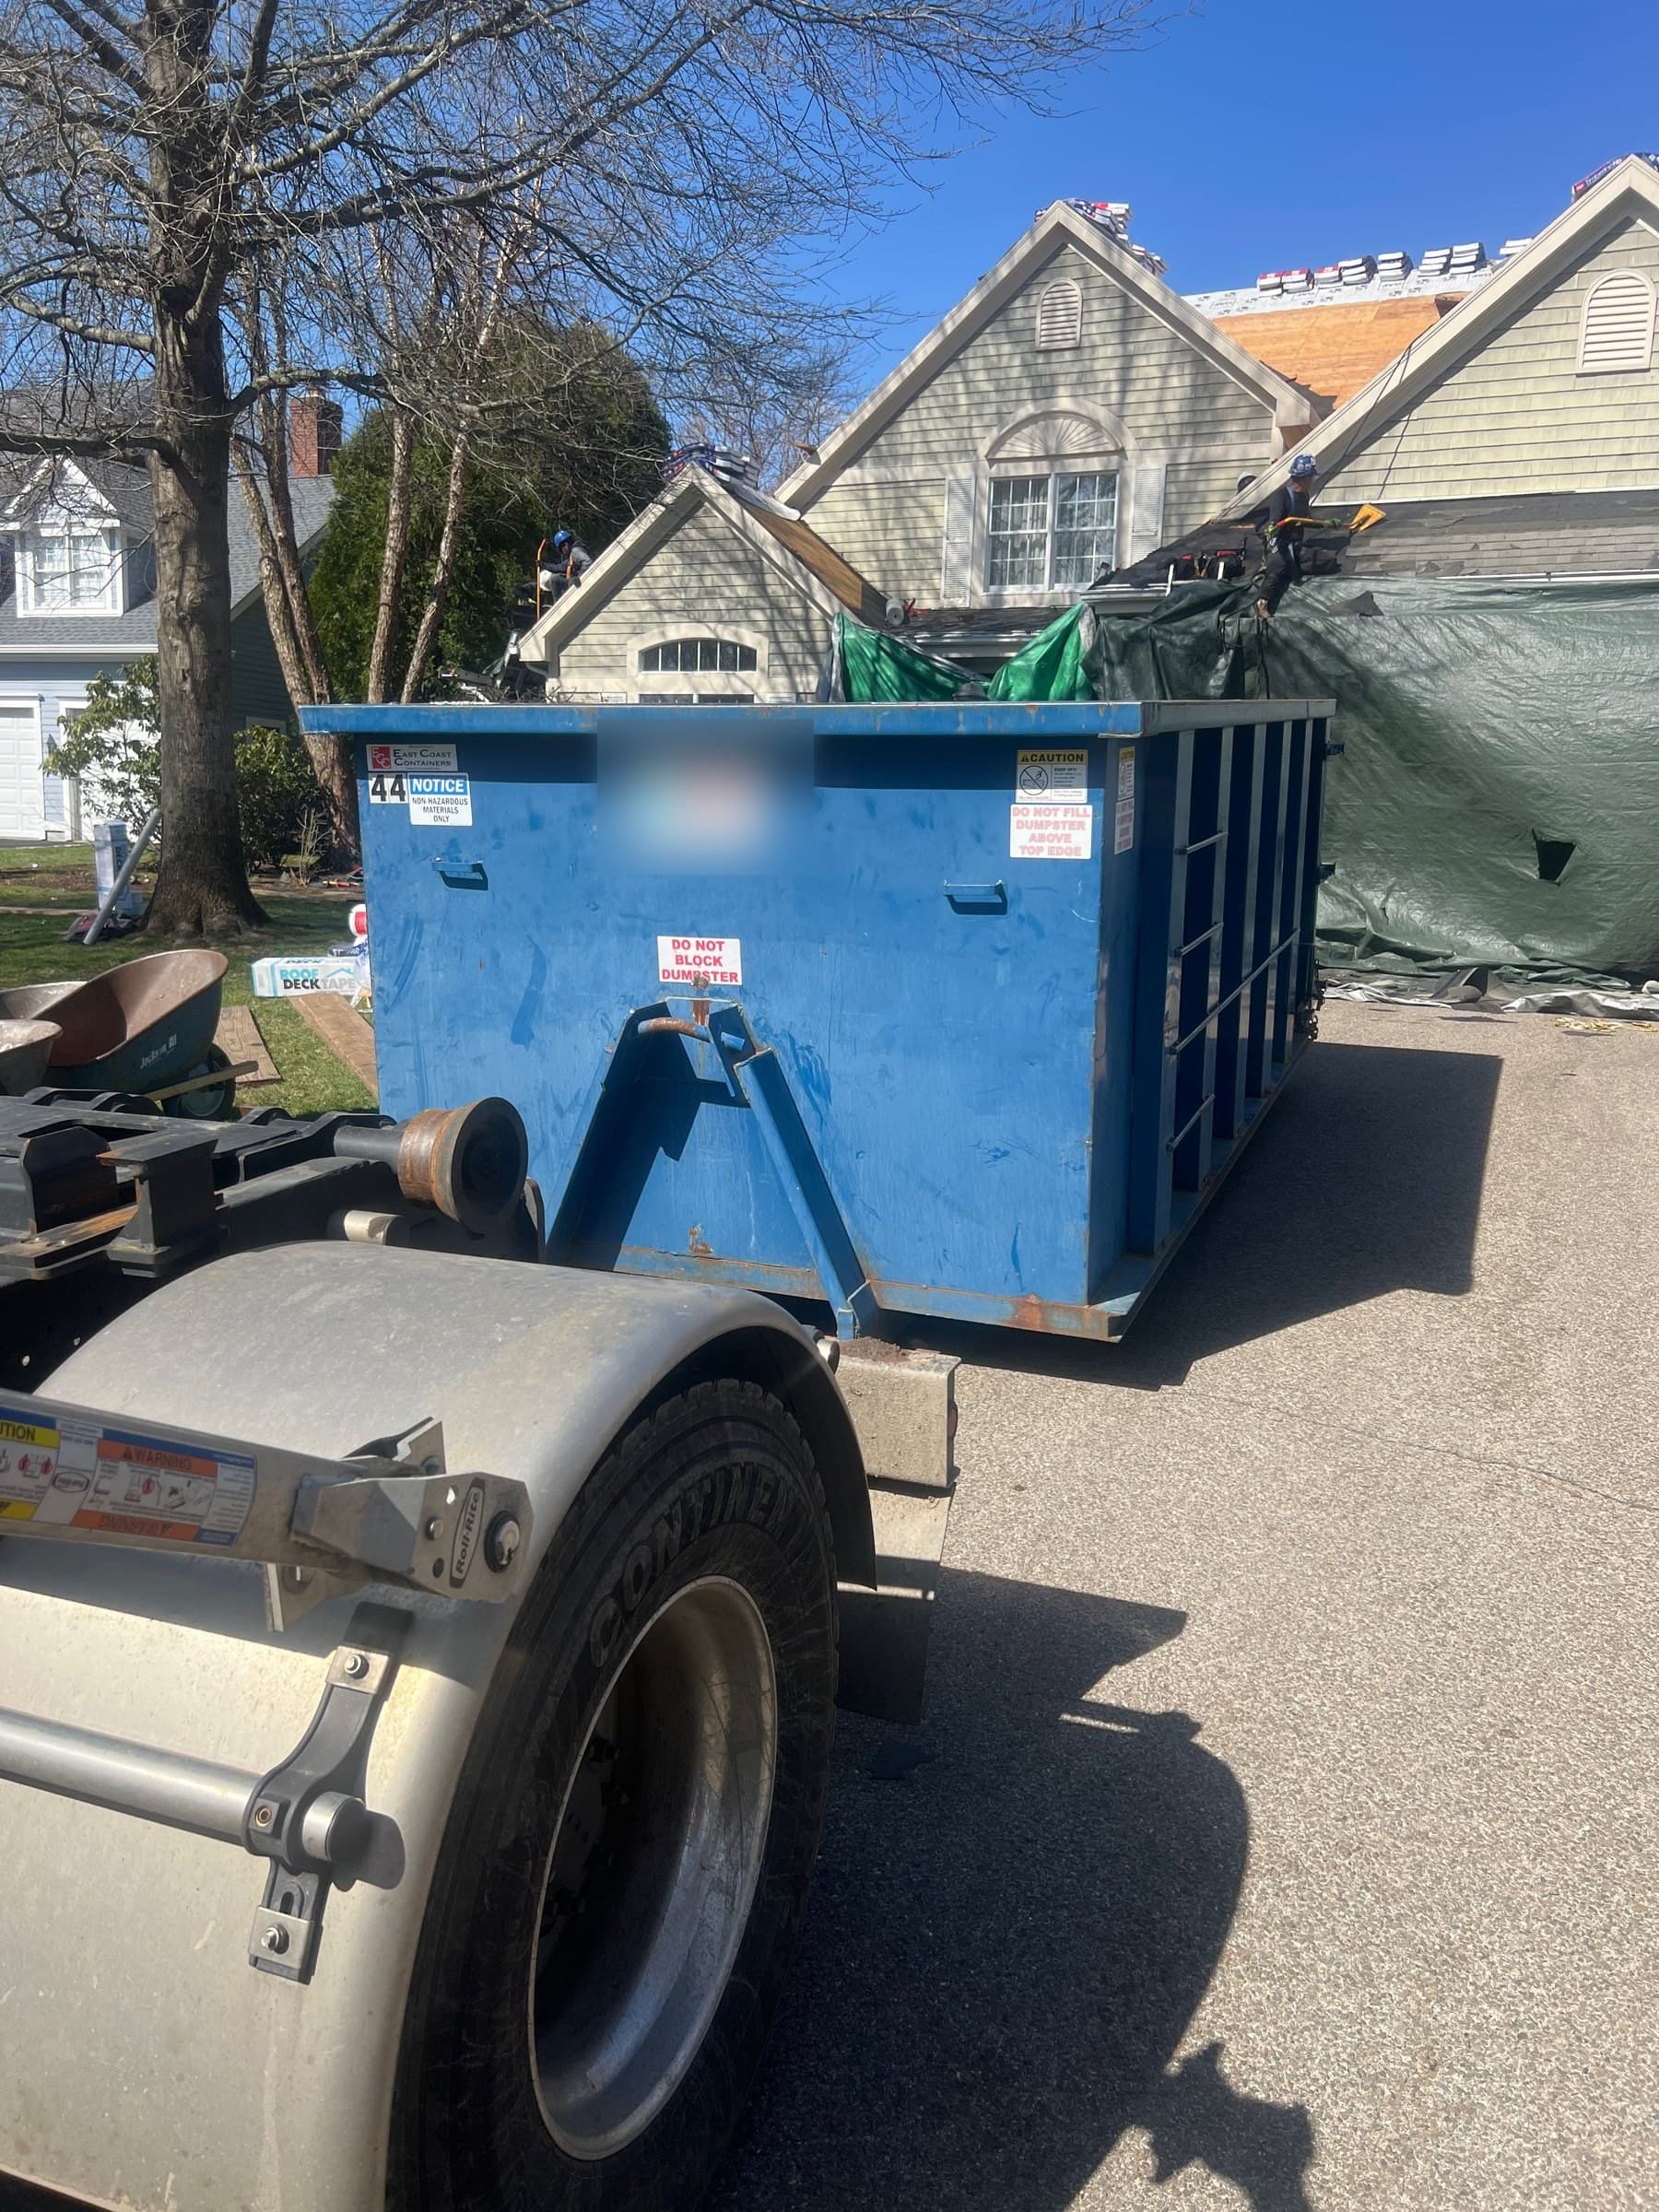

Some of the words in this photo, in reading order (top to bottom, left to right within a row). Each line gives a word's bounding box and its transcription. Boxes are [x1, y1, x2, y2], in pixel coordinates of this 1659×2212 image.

[394, 758, 451, 767] CONTAINERS
[1030, 753, 1084, 762] CAUTION
[371, 774, 406, 802] 44
[412, 779, 465, 793] NOTICE
[1012, 806, 1030, 818] DO
[1033, 806, 1060, 818] NOT
[1064, 807, 1090, 818] FILL
[433, 815, 450, 823] ONLY
[1016, 820, 1086, 830] DUMPSTER
[1029, 833, 1072, 843] ABOVE
[1018, 846, 1043, 856] TOP
[1047, 846, 1082, 856] EDGE
[672, 939, 690, 950] DO
[696, 941, 725, 951] NOT
[675, 955, 723, 967] BLOCK
[280, 969, 319, 980] ROOF
[283, 979, 321, 989] DECK
[0, 1422, 36, 1441] TION
[133, 1447, 192, 1471] WARNING
